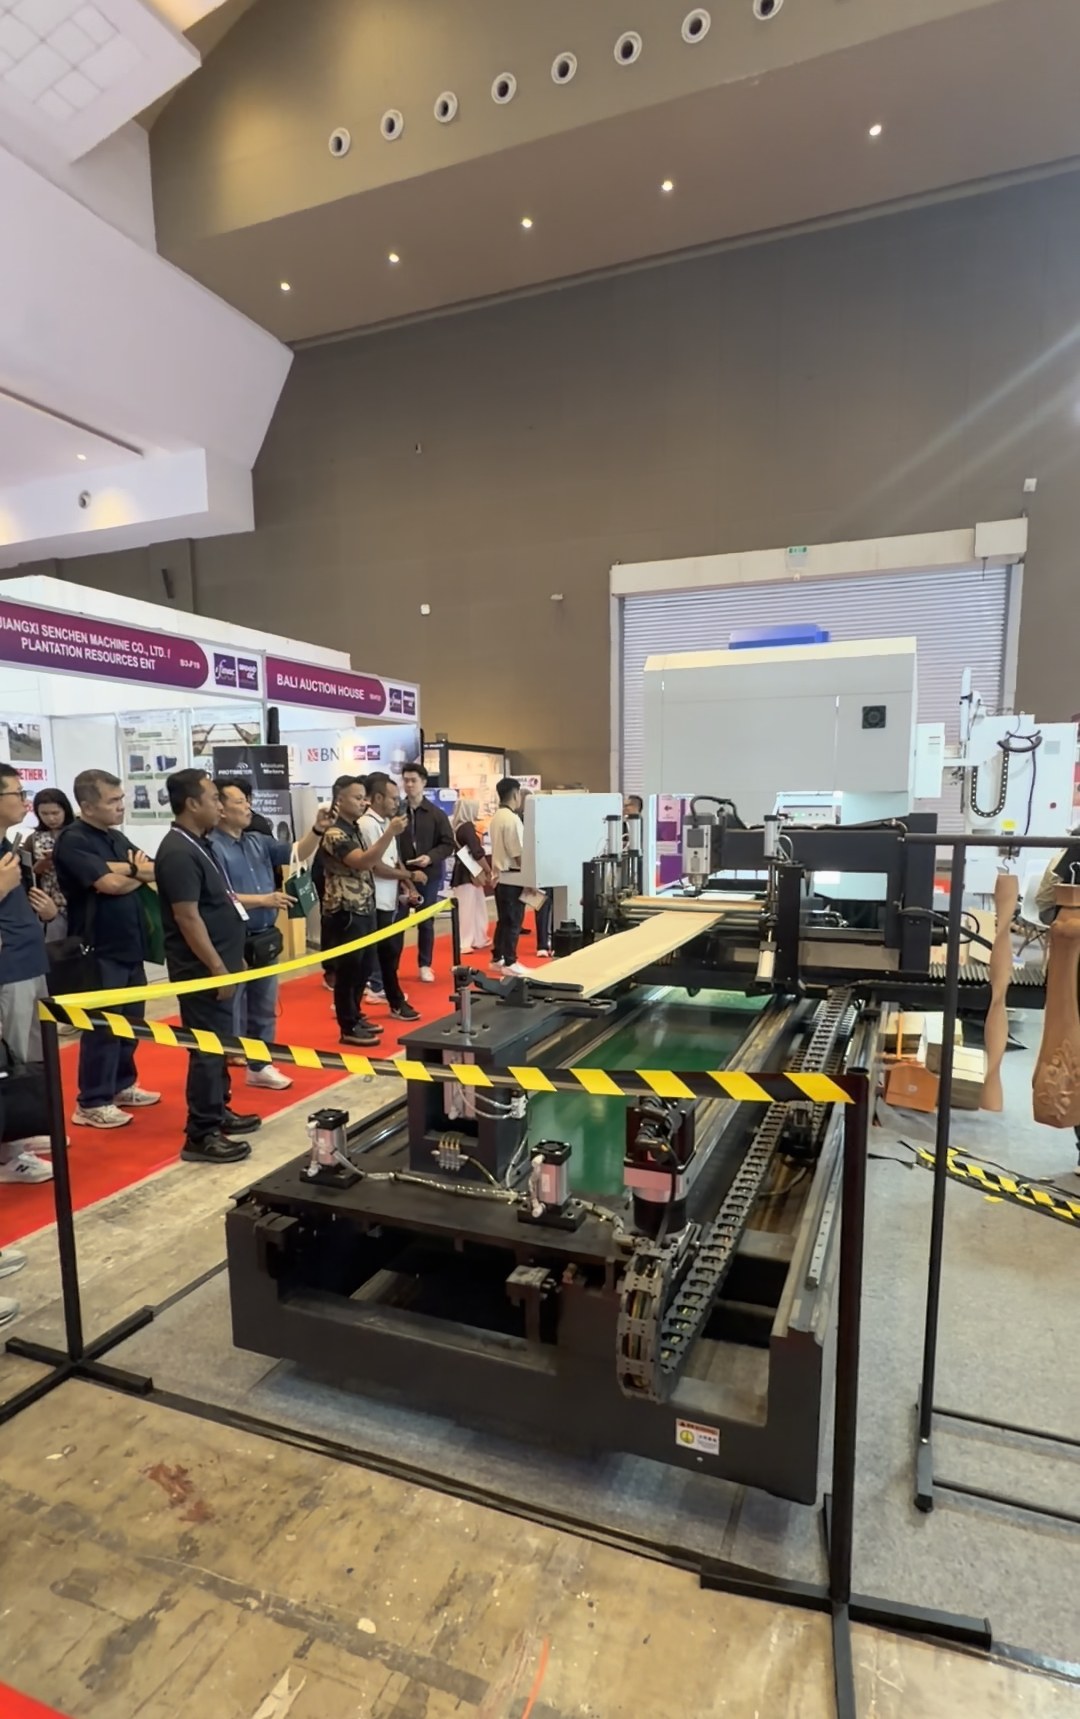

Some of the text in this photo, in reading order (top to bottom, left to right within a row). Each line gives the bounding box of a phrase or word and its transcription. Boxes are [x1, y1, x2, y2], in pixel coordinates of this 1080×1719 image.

[0, 616, 39, 634] JIANGXI
[41, 624, 88, 644] SENCHEN
[90, 634, 130, 652] MACHINE
[150, 644, 167, 659] LTD.
[21, 637, 156, 671] PLANTATION RESOURCES ENT
[277, 673, 298, 688] BALI
[299, 678, 337, 695] AUCTION
[338, 686, 365, 700] HOUSE
